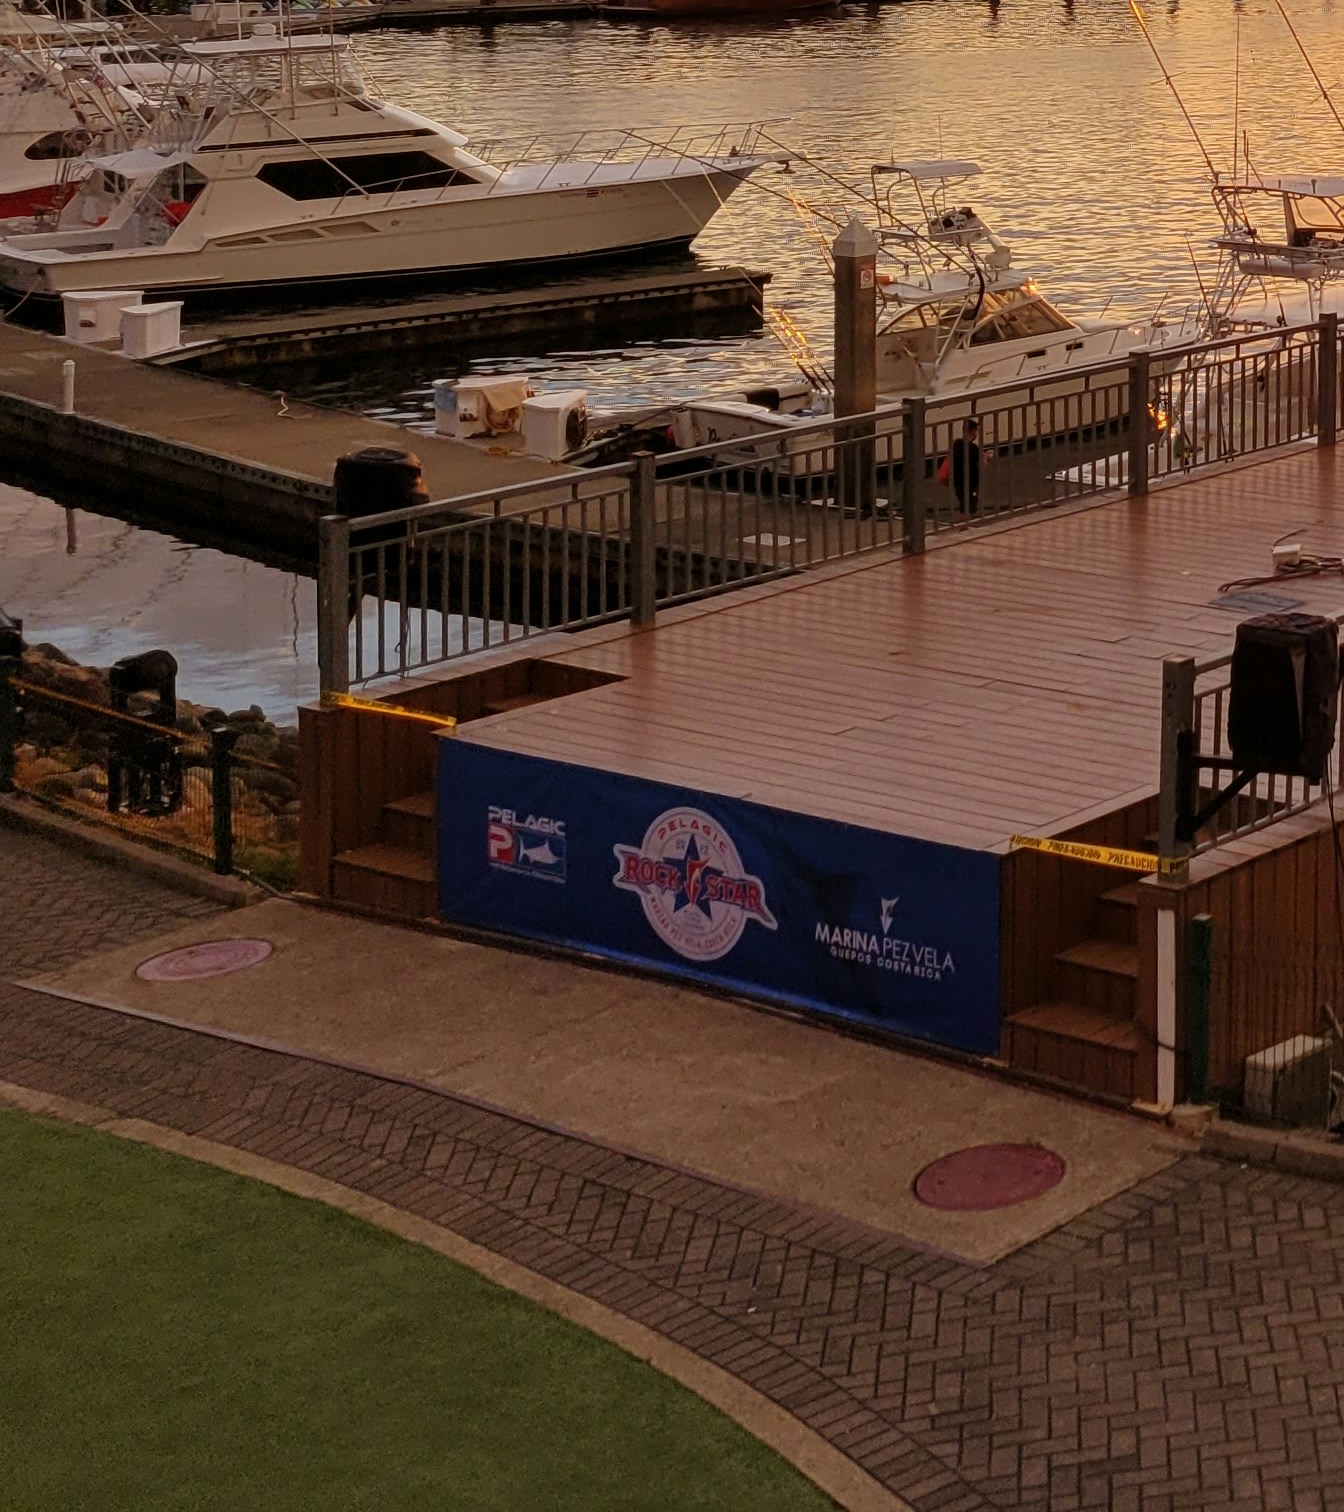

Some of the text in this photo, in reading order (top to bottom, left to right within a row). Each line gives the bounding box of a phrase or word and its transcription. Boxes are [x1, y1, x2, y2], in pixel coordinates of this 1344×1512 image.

[487, 805, 566, 836] PELAGIC
[657, 819, 728, 854] PELAGIC
[623, 851, 769, 916] ROCK STAR
[815, 922, 880, 955] MARINA
[830, 946, 941, 982] QUEPOS COSTA RICA
